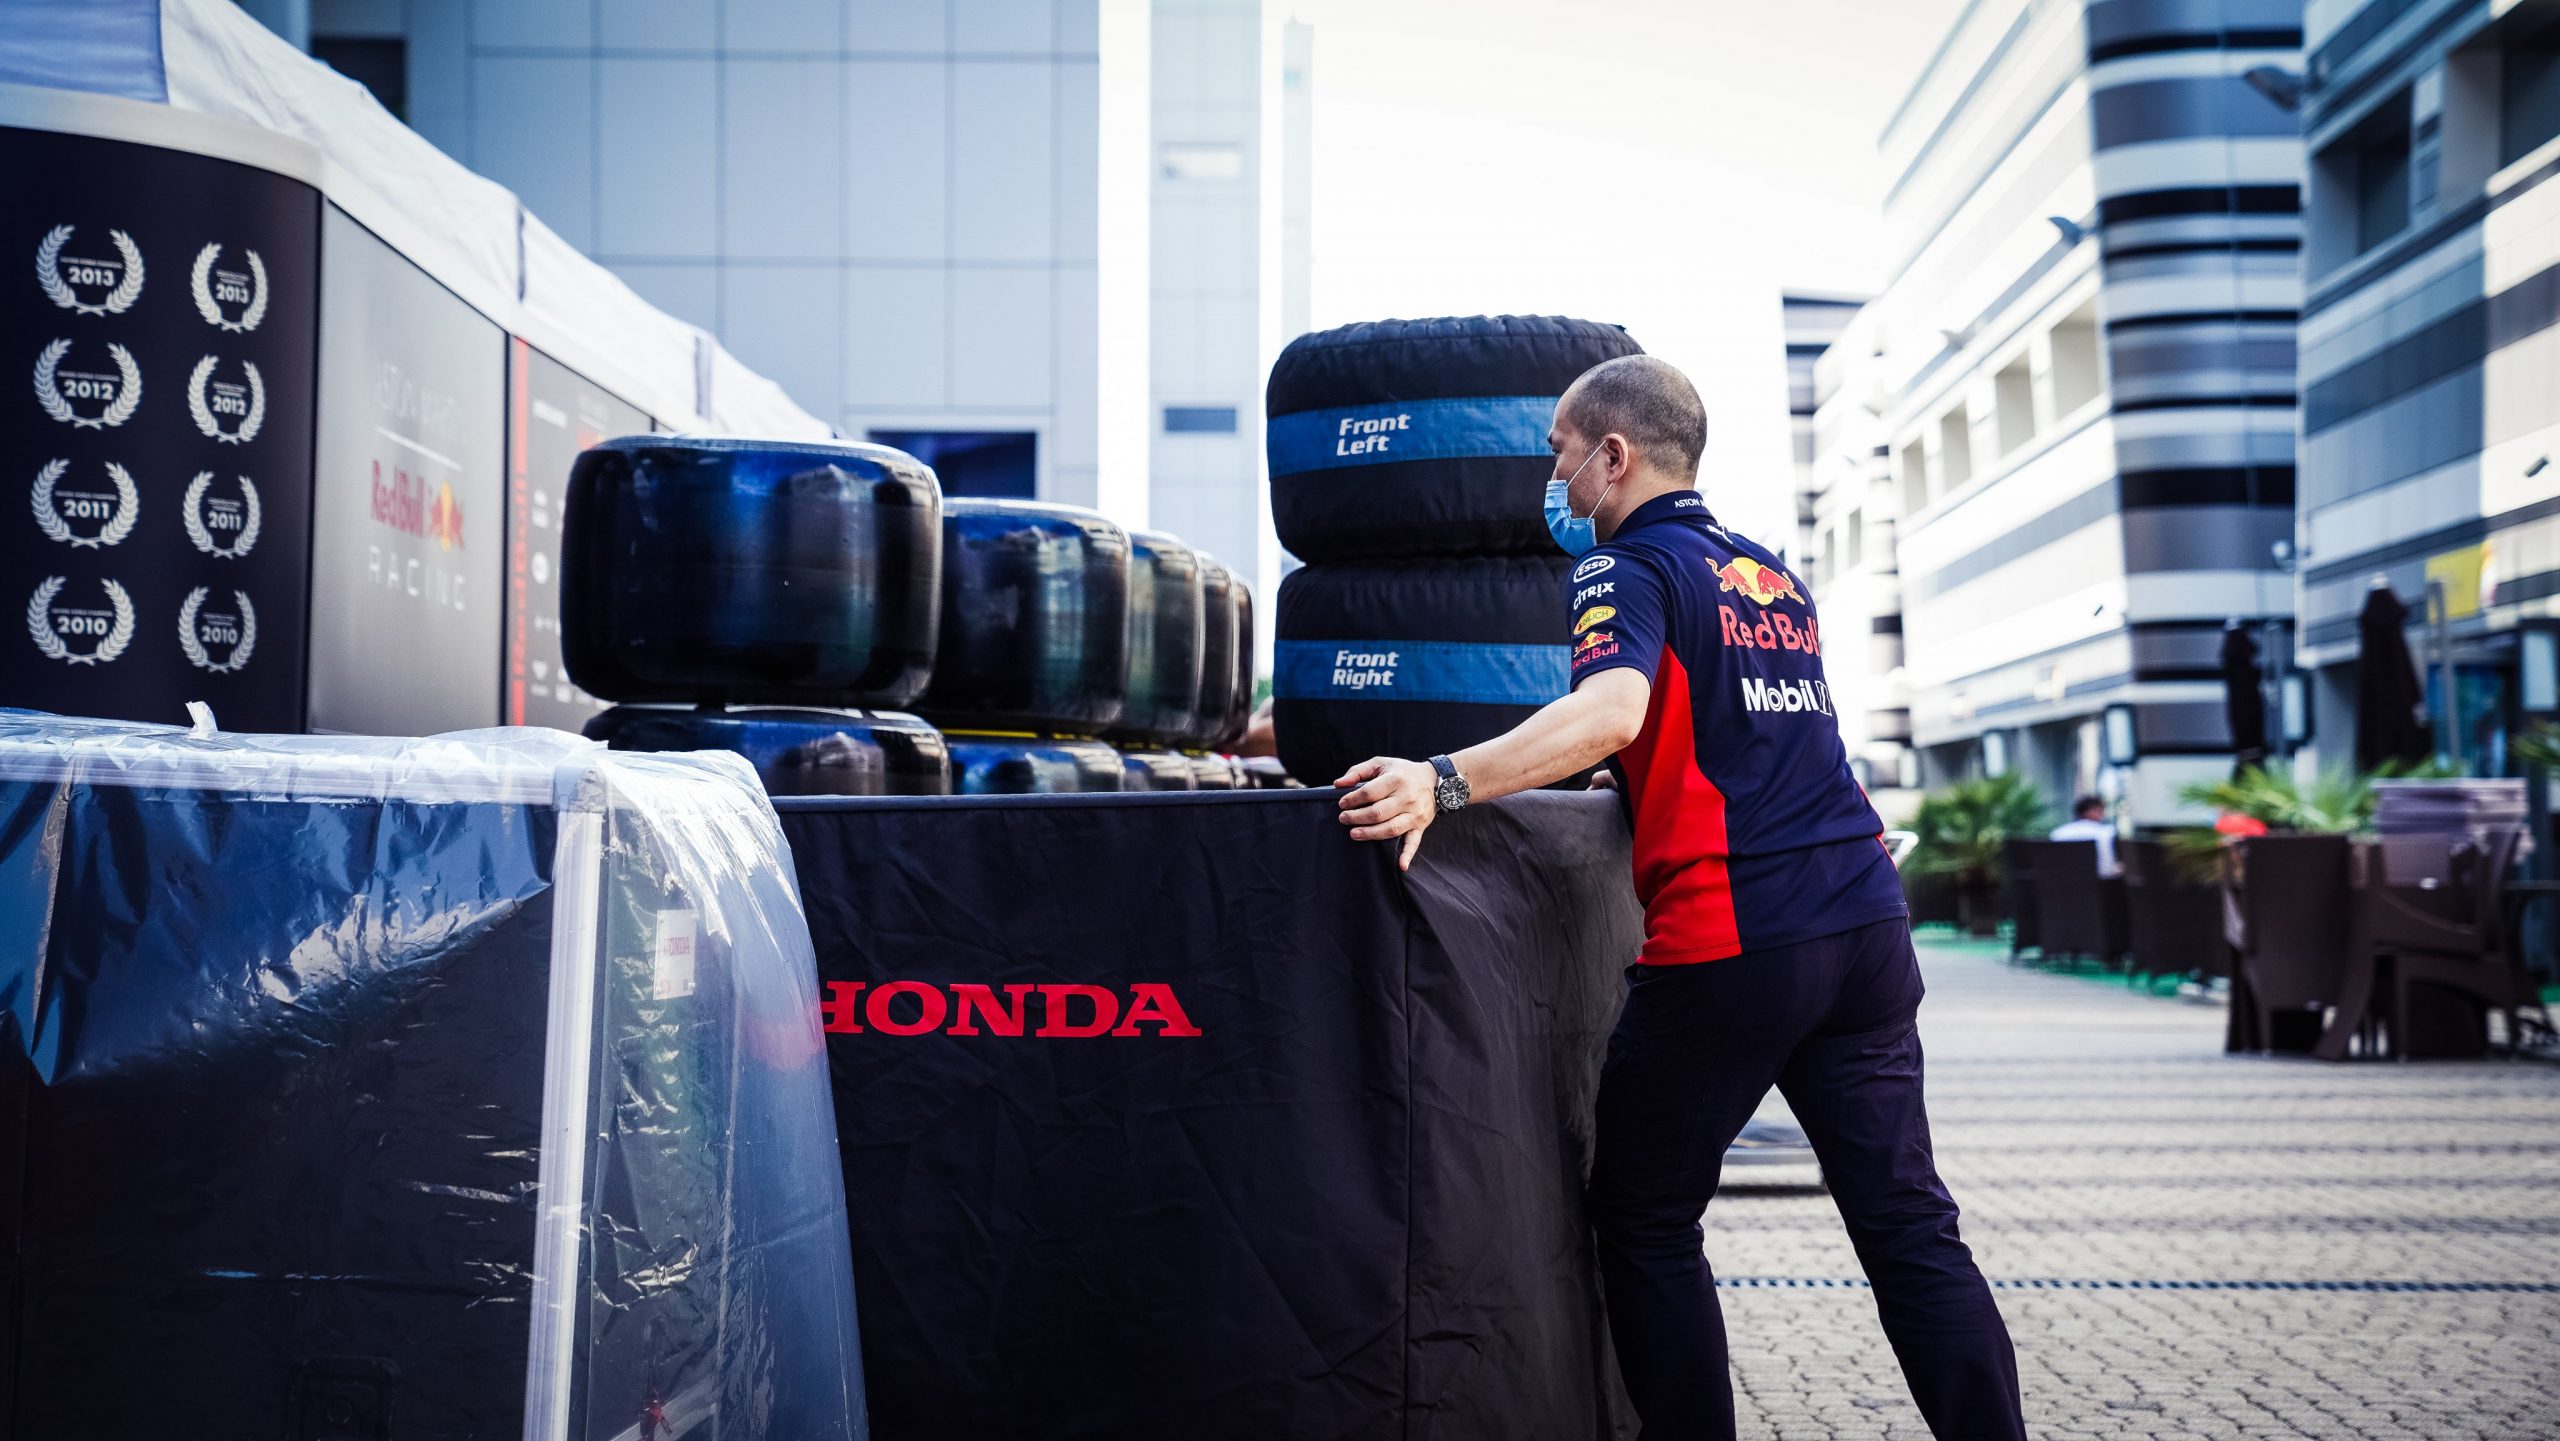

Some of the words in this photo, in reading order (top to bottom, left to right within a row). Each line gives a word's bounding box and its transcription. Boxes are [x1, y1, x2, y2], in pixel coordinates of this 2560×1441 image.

[68, 266, 115, 287] 2013
[215, 282, 249, 304] 2013
[63, 379, 114, 400] 2012
[212, 395, 246, 416] 2012
[1339, 413, 1411, 436] Front
[1336, 434, 1390, 456] Left
[63, 500, 110, 519] 2011
[1674, 498, 1700, 508] ASTON
[208, 511, 241, 530] 2011
[57, 615, 108, 636] 2010
[202, 625, 238, 645] 2010
[1718, 605, 1778, 650] Red
[1336, 650, 1400, 668] Front
[1592, 643, 1619, 659] Bull
[1332, 668, 1394, 690] Right
[1741, 678, 1820, 713] Mobil
[820, 980, 1203, 1038] HONDA
